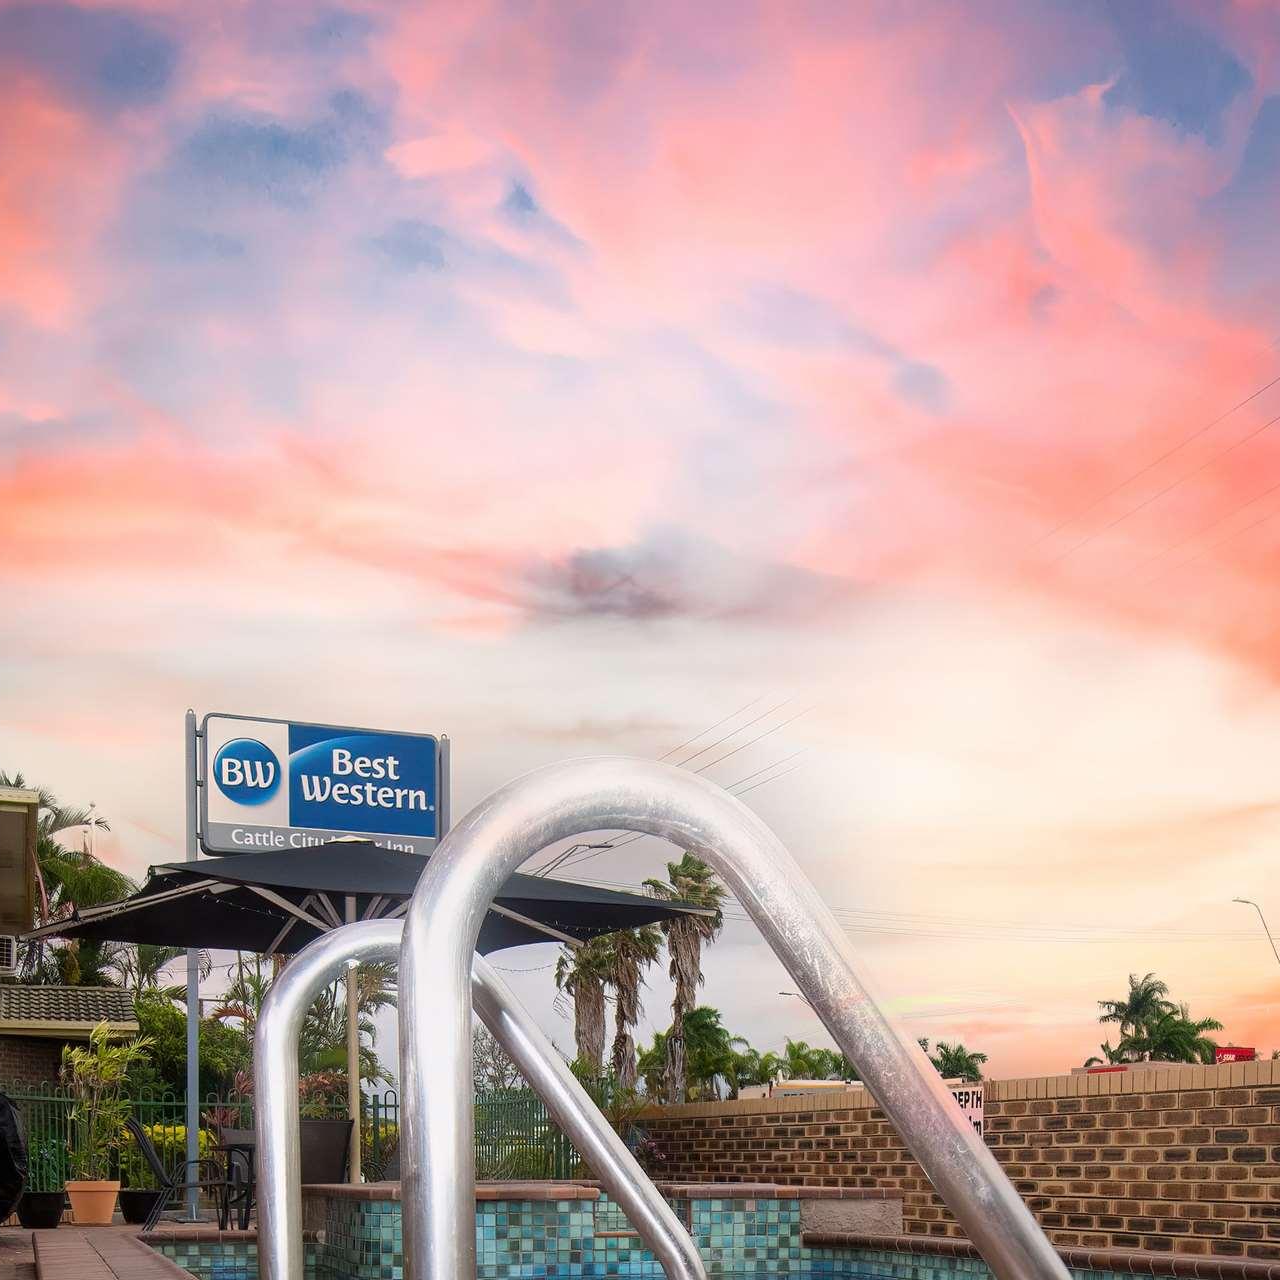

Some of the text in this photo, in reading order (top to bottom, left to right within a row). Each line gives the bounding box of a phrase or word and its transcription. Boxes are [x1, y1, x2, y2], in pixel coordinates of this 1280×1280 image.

[221, 757, 274, 788] BW
[332, 749, 400, 781] Best
[231, 829, 285, 847] Cattle
[387, 840, 415, 854] Inn
